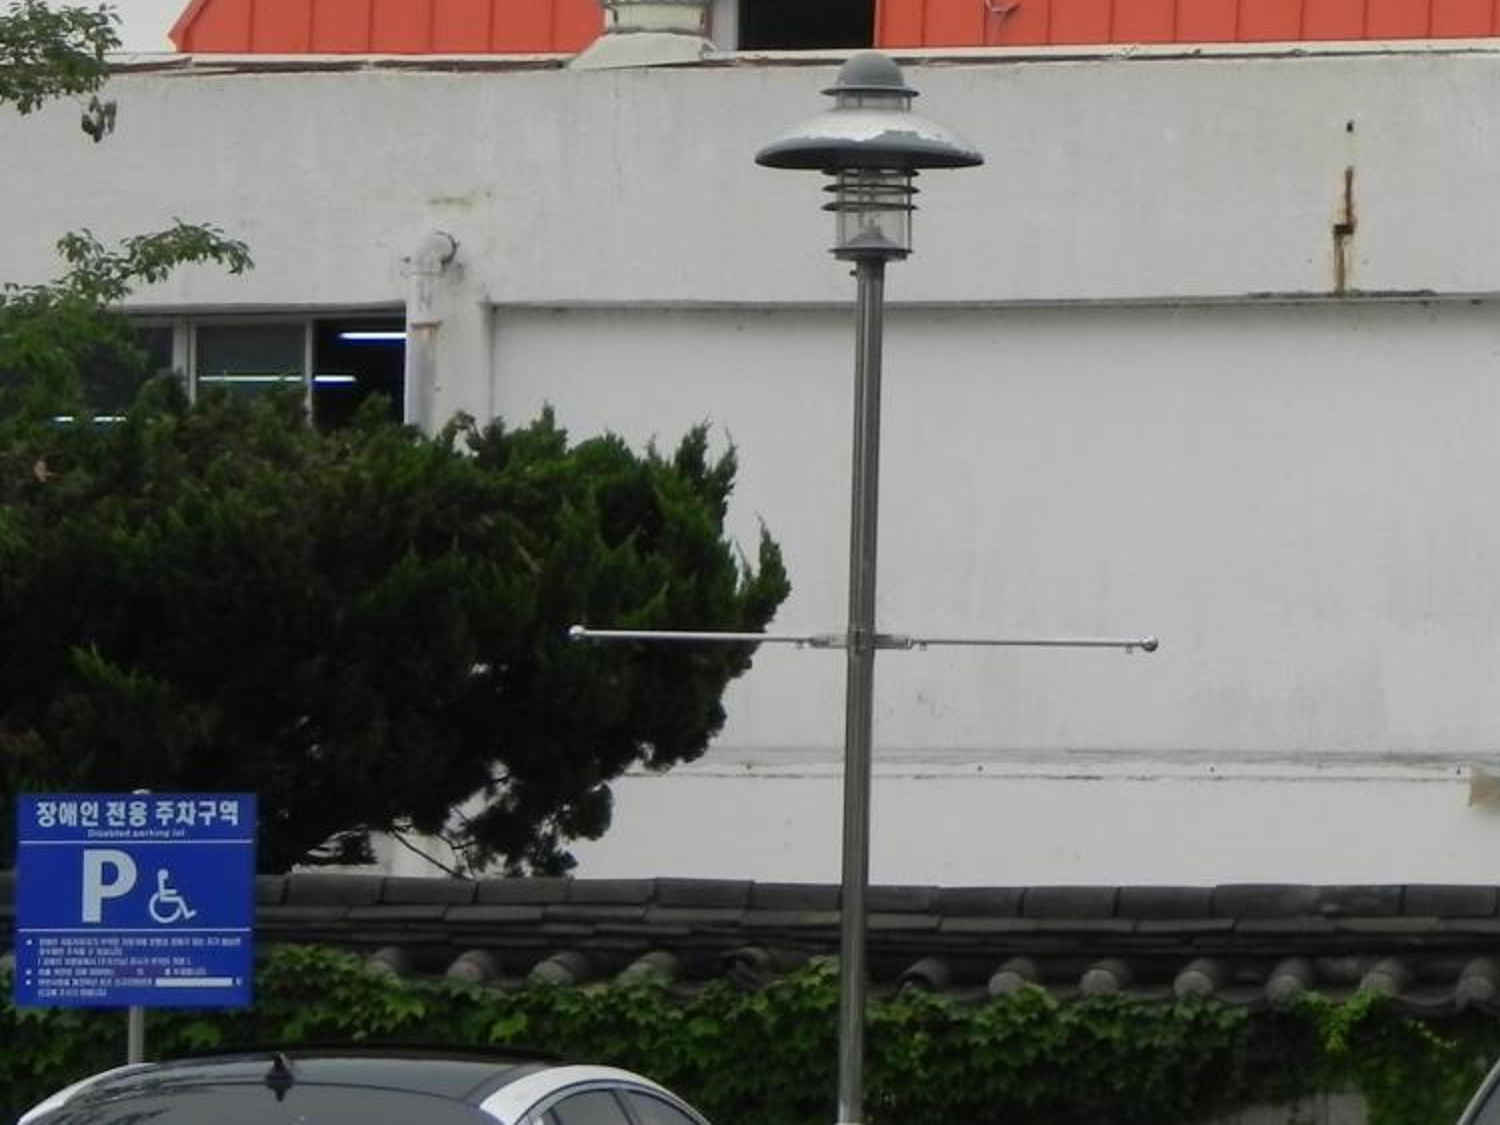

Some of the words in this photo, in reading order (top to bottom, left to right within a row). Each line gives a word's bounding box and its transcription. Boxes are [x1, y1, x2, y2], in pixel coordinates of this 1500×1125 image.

[36, 800, 99, 828] 장애인
[106, 800, 147, 827] 전용
[155, 800, 239, 827] 주차구역
[82, 848, 137, 924] P
